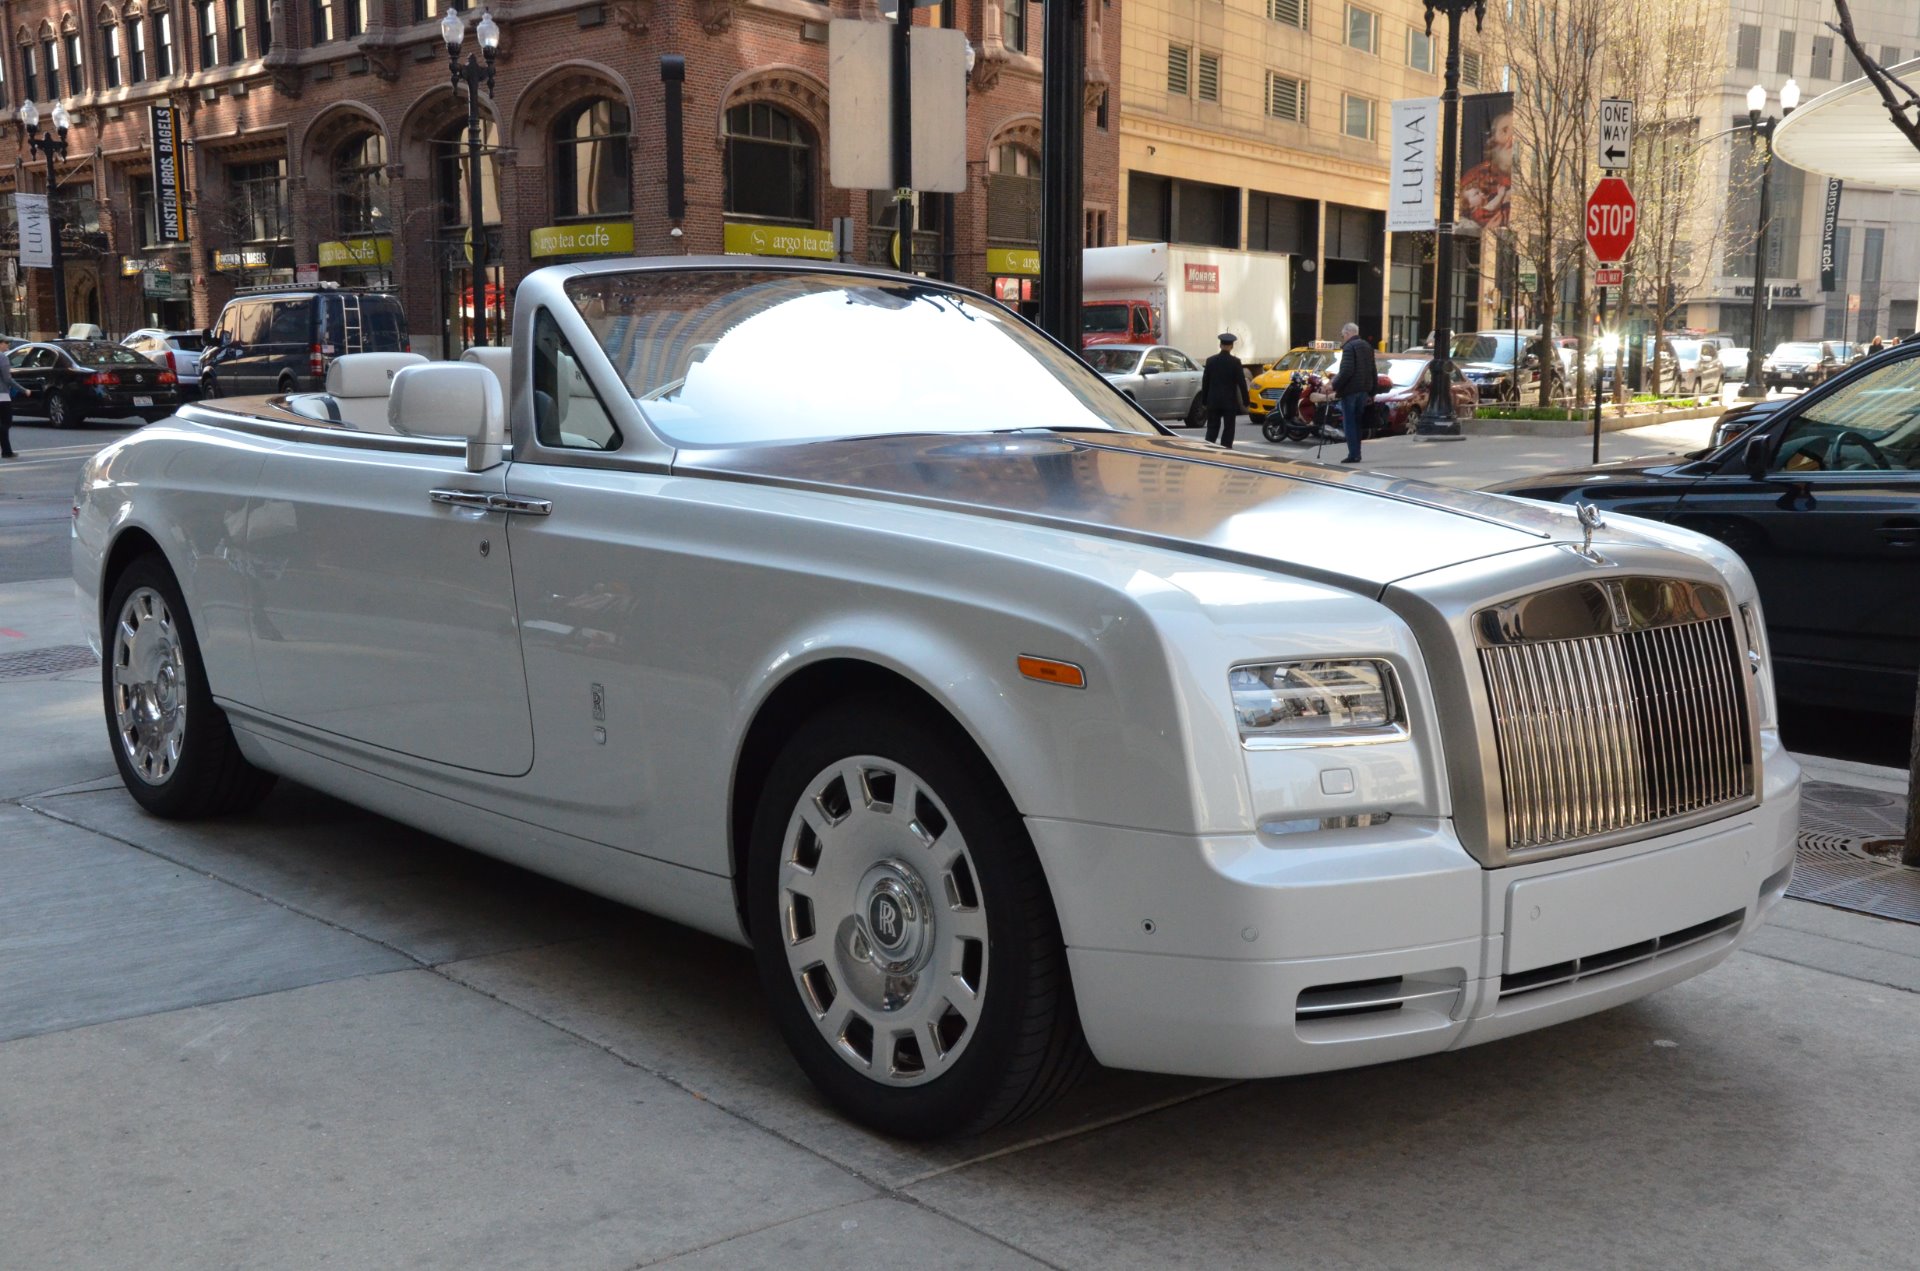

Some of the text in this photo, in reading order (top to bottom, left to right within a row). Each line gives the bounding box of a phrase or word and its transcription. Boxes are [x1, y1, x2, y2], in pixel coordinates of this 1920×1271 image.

[1604, 106, 1629, 123] ONE
[1603, 125, 1629, 142] WAY
[1402, 115, 1425, 205] LUMA
[157, 109, 179, 239] EINSTEIN BROS. BAGELS
[1588, 204, 1634, 237] STOP
[560, 233, 575, 248] tea
[578, 224, 609, 247] café
[773, 235, 800, 254] argo
[803, 235, 817, 251] tea
[350, 241, 375, 260] café
[1821, 243, 1834, 272] rack
[1022, 257, 1040, 273] arg
[1189, 268, 1217, 282] MONROE
[1597, 271, 1620, 283] ALL WAY
[1783, 283, 1802, 298] rack
